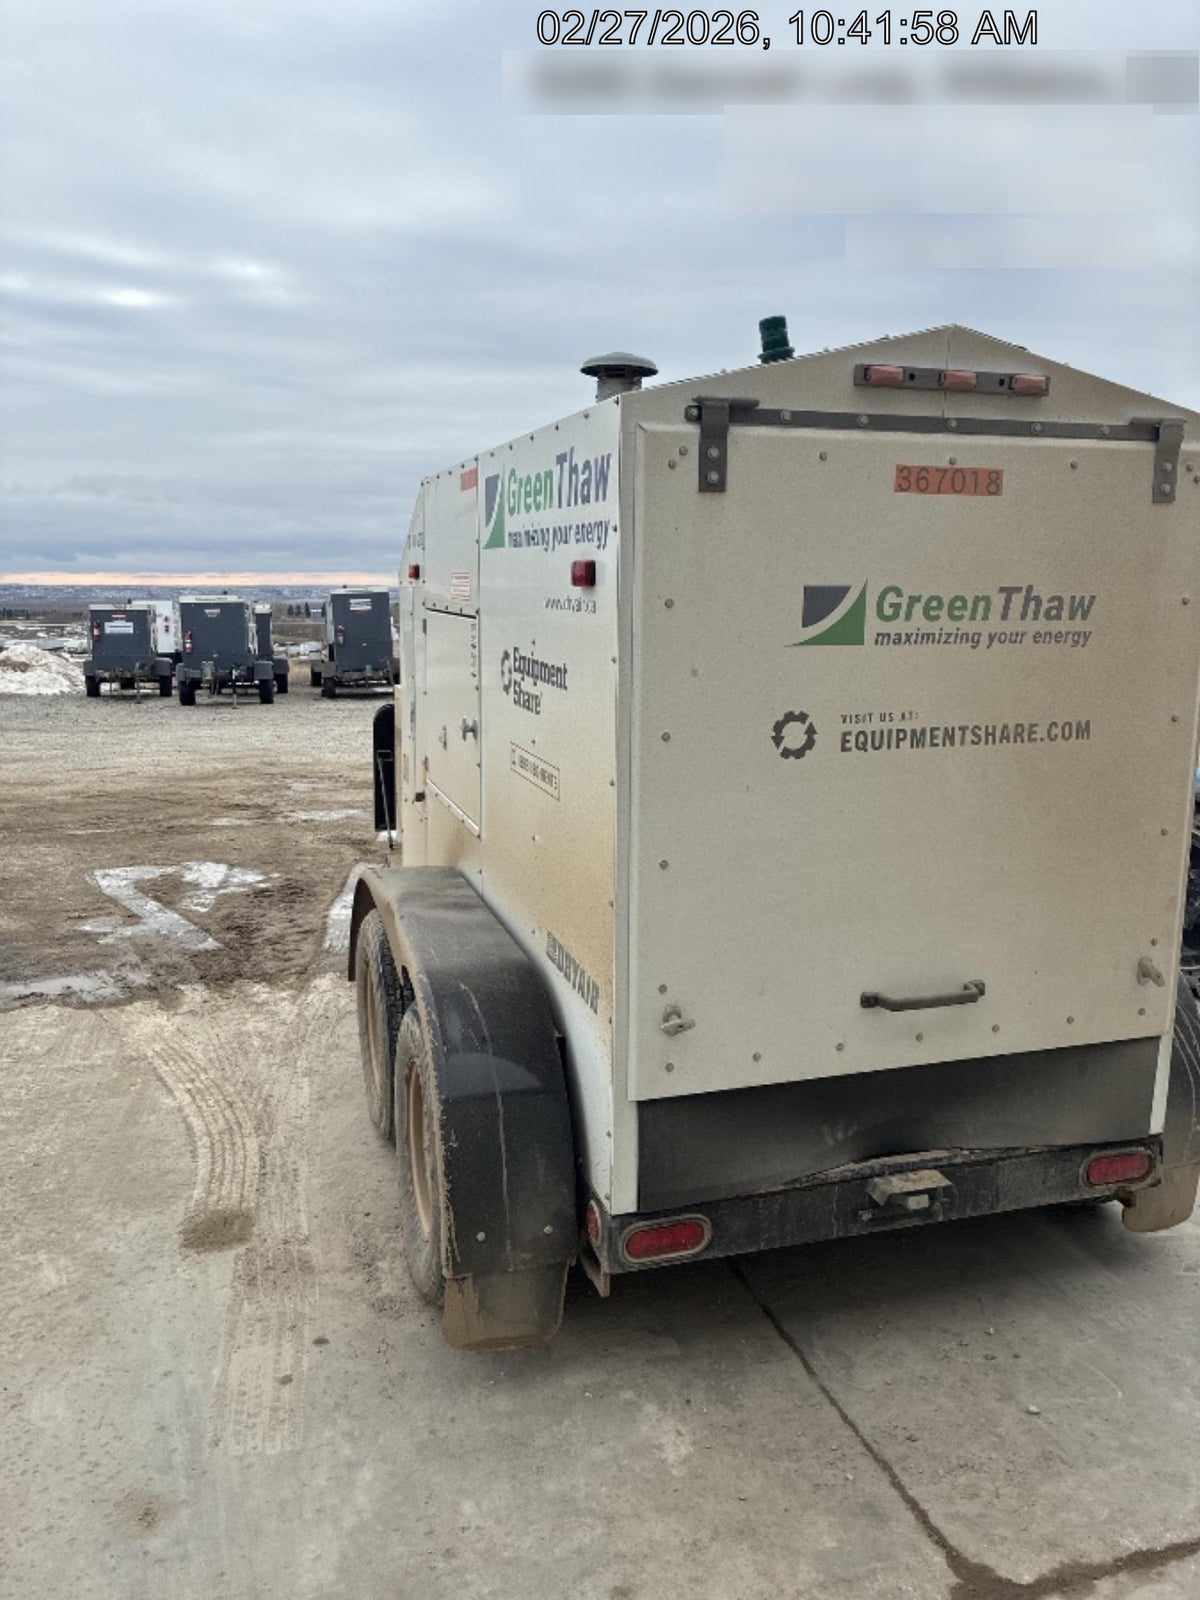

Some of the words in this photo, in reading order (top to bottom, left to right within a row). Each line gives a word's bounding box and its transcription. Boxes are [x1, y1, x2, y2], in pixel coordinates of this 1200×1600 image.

[897, 466, 999, 493] 367018
[552, 525, 572, 550] your
[575, 519, 609, 549] energy
[874, 627, 980, 647] maximizing
[986, 629, 1026, 649] your
[1032, 629, 1092, 647] energy
[513, 647, 567, 691] Equipment
[513, 679, 541, 715] Share
[841, 712, 873, 724] VISIT
[880, 712, 894, 722] US
[841, 720, 1091, 752] EQUIPMENTSHARE.COM
